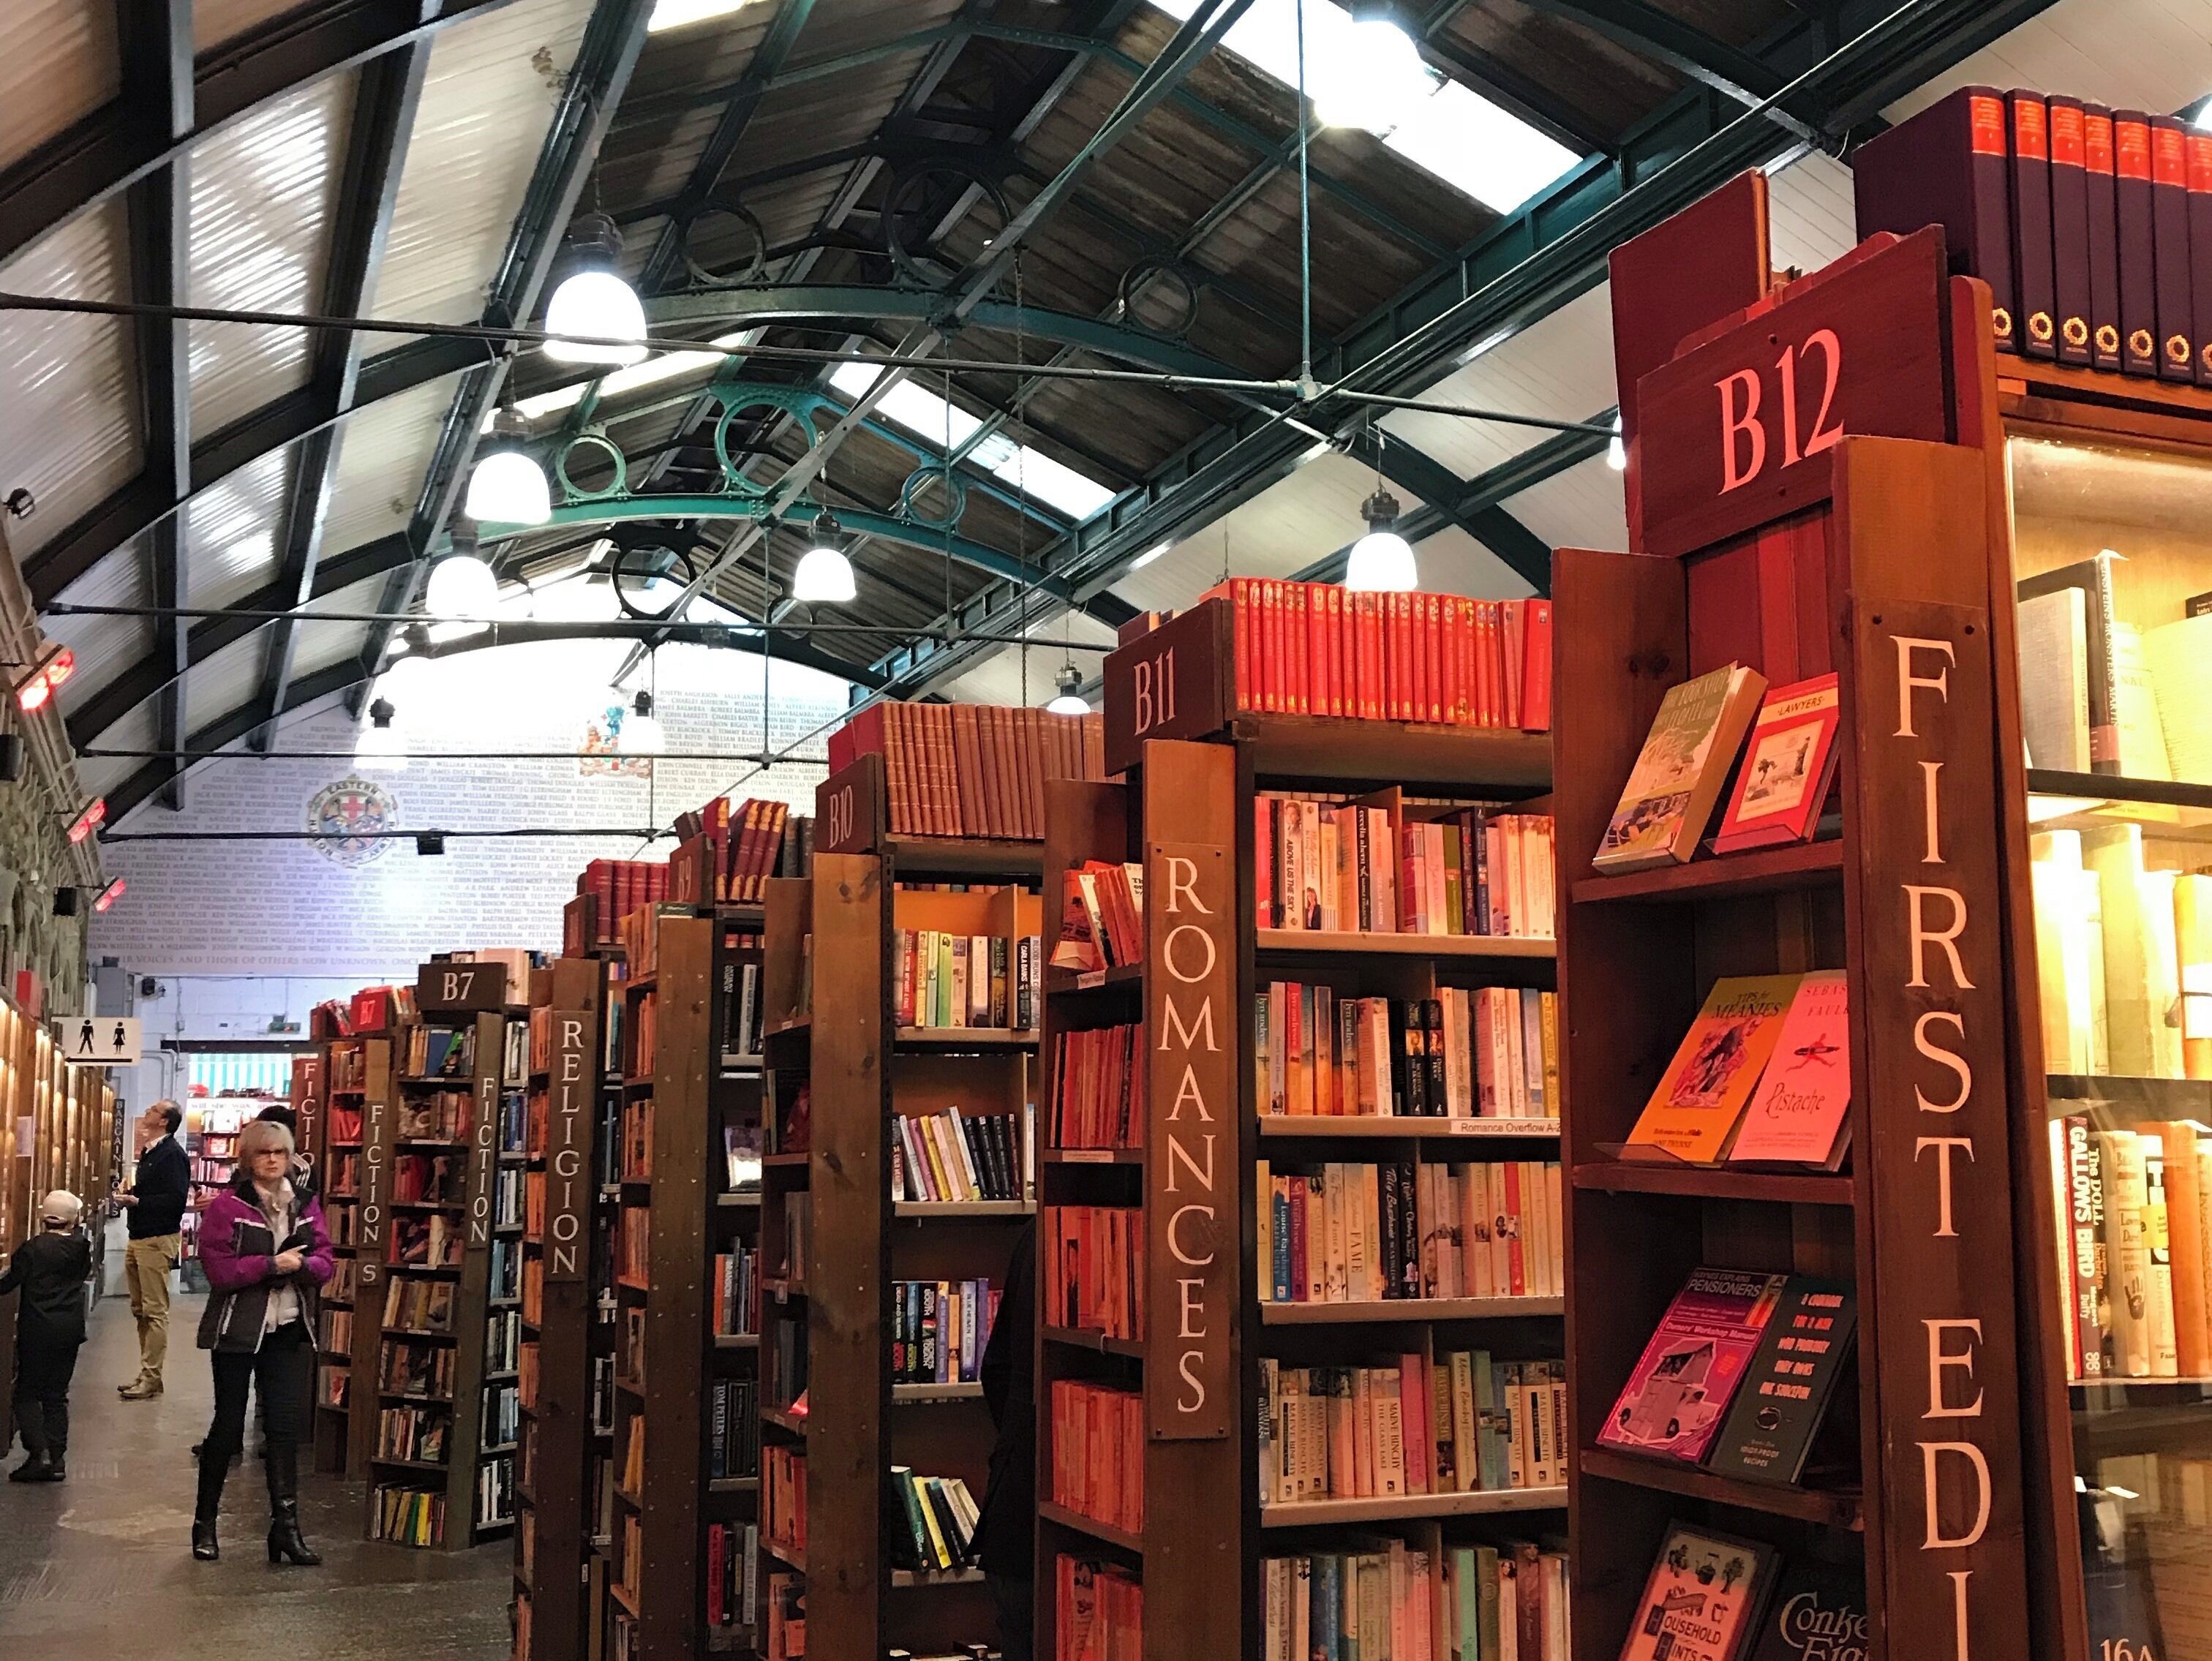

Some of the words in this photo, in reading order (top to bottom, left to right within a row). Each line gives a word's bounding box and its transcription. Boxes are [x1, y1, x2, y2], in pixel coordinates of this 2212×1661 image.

[1714, 328, 1844, 495] B12
[2104, 624, 2115, 682] MONSTERS
[1134, 646, 1176, 736] B11
[2109, 687, 2118, 726] MARTIN
[828, 785, 853, 849] B10
[1286, 839, 1294, 866] ABOVE
[1286, 867, 1294, 878] US
[1286, 879, 1294, 895] THE
[1287, 896, 1295, 914] SKY
[1889, 635, 1976, 1237] FIRST
[136, 954, 173, 963] VOICES
[1020, 945, 1028, 963] CARLA
[443, 972, 474, 1001] B7
[1020, 964, 1028, 982] BANKS
[1712, 1002, 1782, 1019] MEANIES
[299, 1062, 317, 1166] FICTIO
[1766, 1082, 1826, 1119] Pistache
[113, 1100, 124, 1162] BARGAIN
[1157, 856, 1222, 1413] ROMANCES
[1461, 1122, 1503, 1132] Romance
[1505, 1122, 1545, 1132] Overflow
[470, 1078, 494, 1243] FICTION
[552, 1020, 584, 1273] RELIGION
[2087, 1148, 2100, 1177] The
[363, 1104, 384, 1243] FICTION
[2069, 1126, 2092, 1222] GALLOWS
[2090, 1178, 2104, 1226] DOLL
[1350, 1231, 1363, 1273] FAME
[2075, 1228, 2096, 1278] BIRD
[1687, 1279, 1762, 1297] PENSIONERS
[2079, 1293, 2091, 1319] Duffy
[1694, 1325, 1728, 1338] Workshop
[1728, 1330, 1758, 1340] Manual
[716, 1384, 726, 1404] TOM
[1539, 1391, 1549, 1423] MAEVE
[1389, 1402, 1399, 1433] MAEVE
[1390, 1434, 1401, 1470] BINCHY
[1541, 1428, 1550, 1462] BINCHY
[1644, 1605, 1721, 1645] HOUSEHOLD
[1655, 1632, 1698, 1661] HINTS
